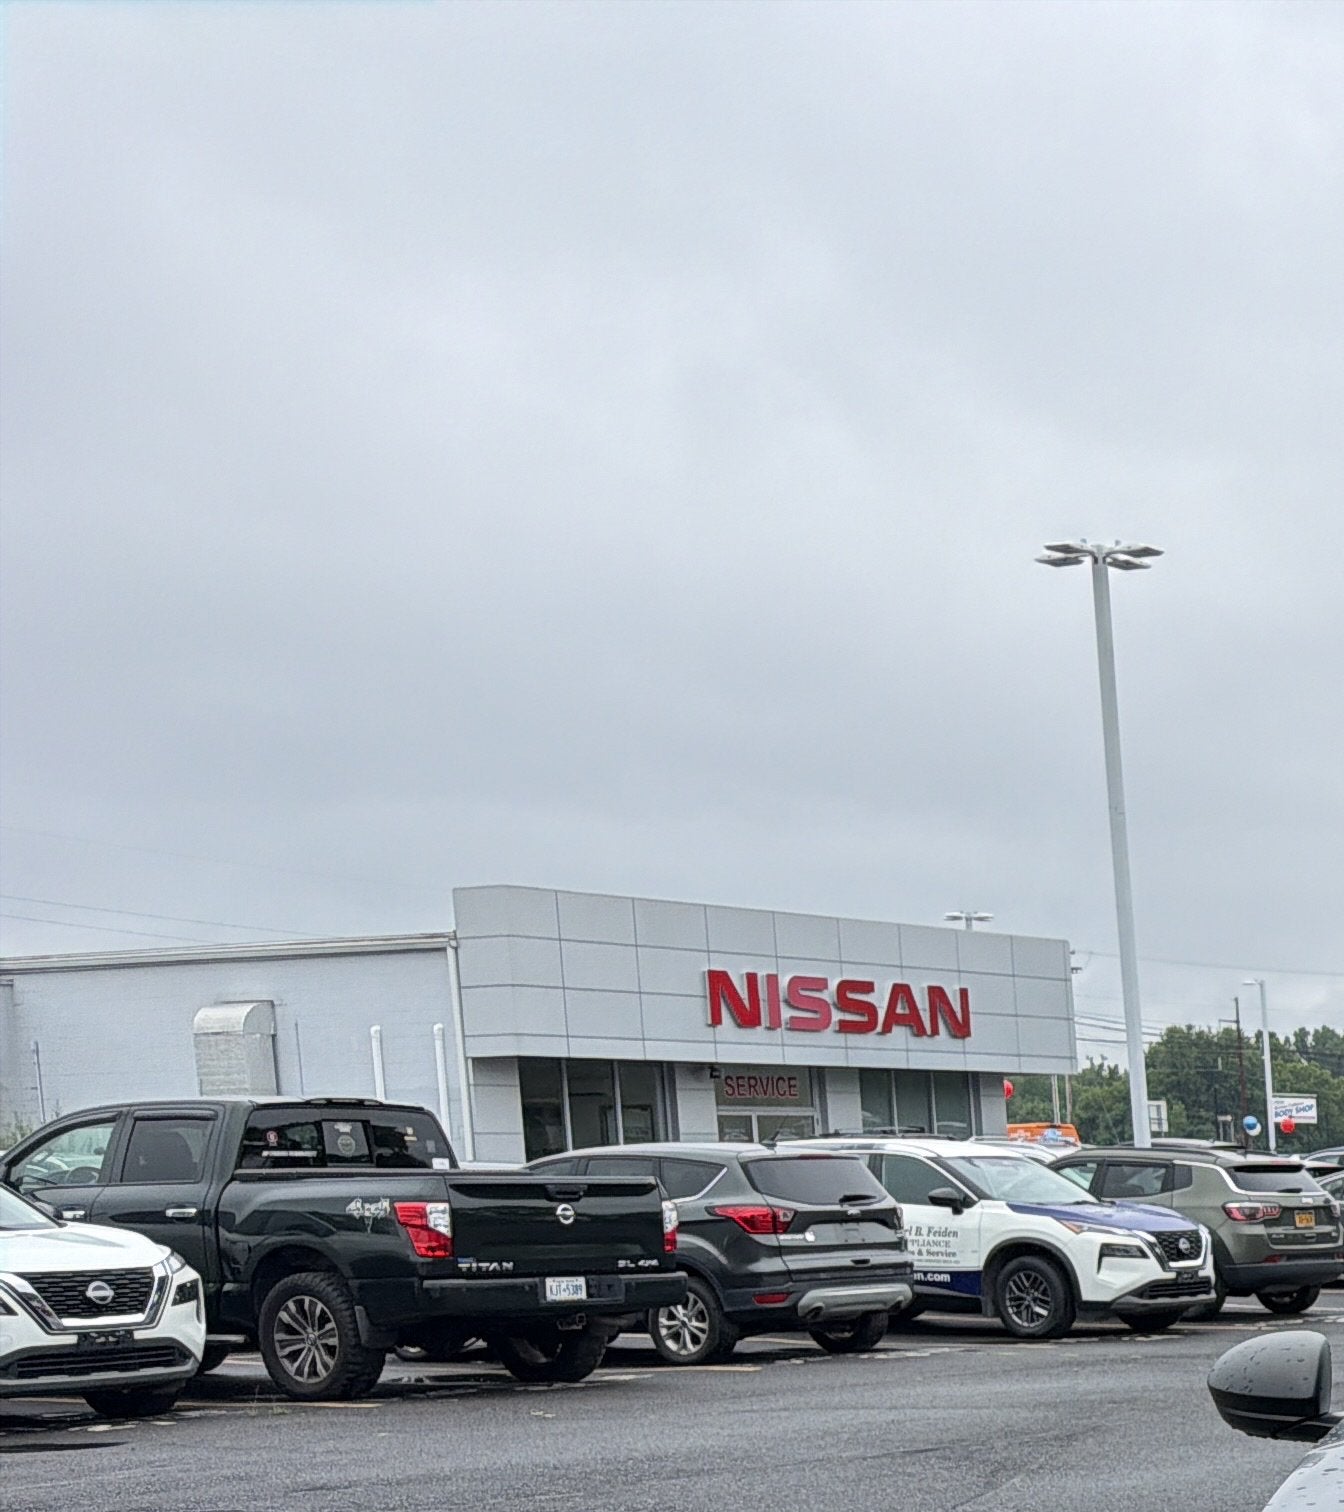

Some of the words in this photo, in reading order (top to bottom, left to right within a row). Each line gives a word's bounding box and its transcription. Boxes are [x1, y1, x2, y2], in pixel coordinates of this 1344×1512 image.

[707, 969, 972, 1039] NISSAN
[724, 1075, 799, 1098] SERVICE
[457, 1261, 514, 1272] TITAN
